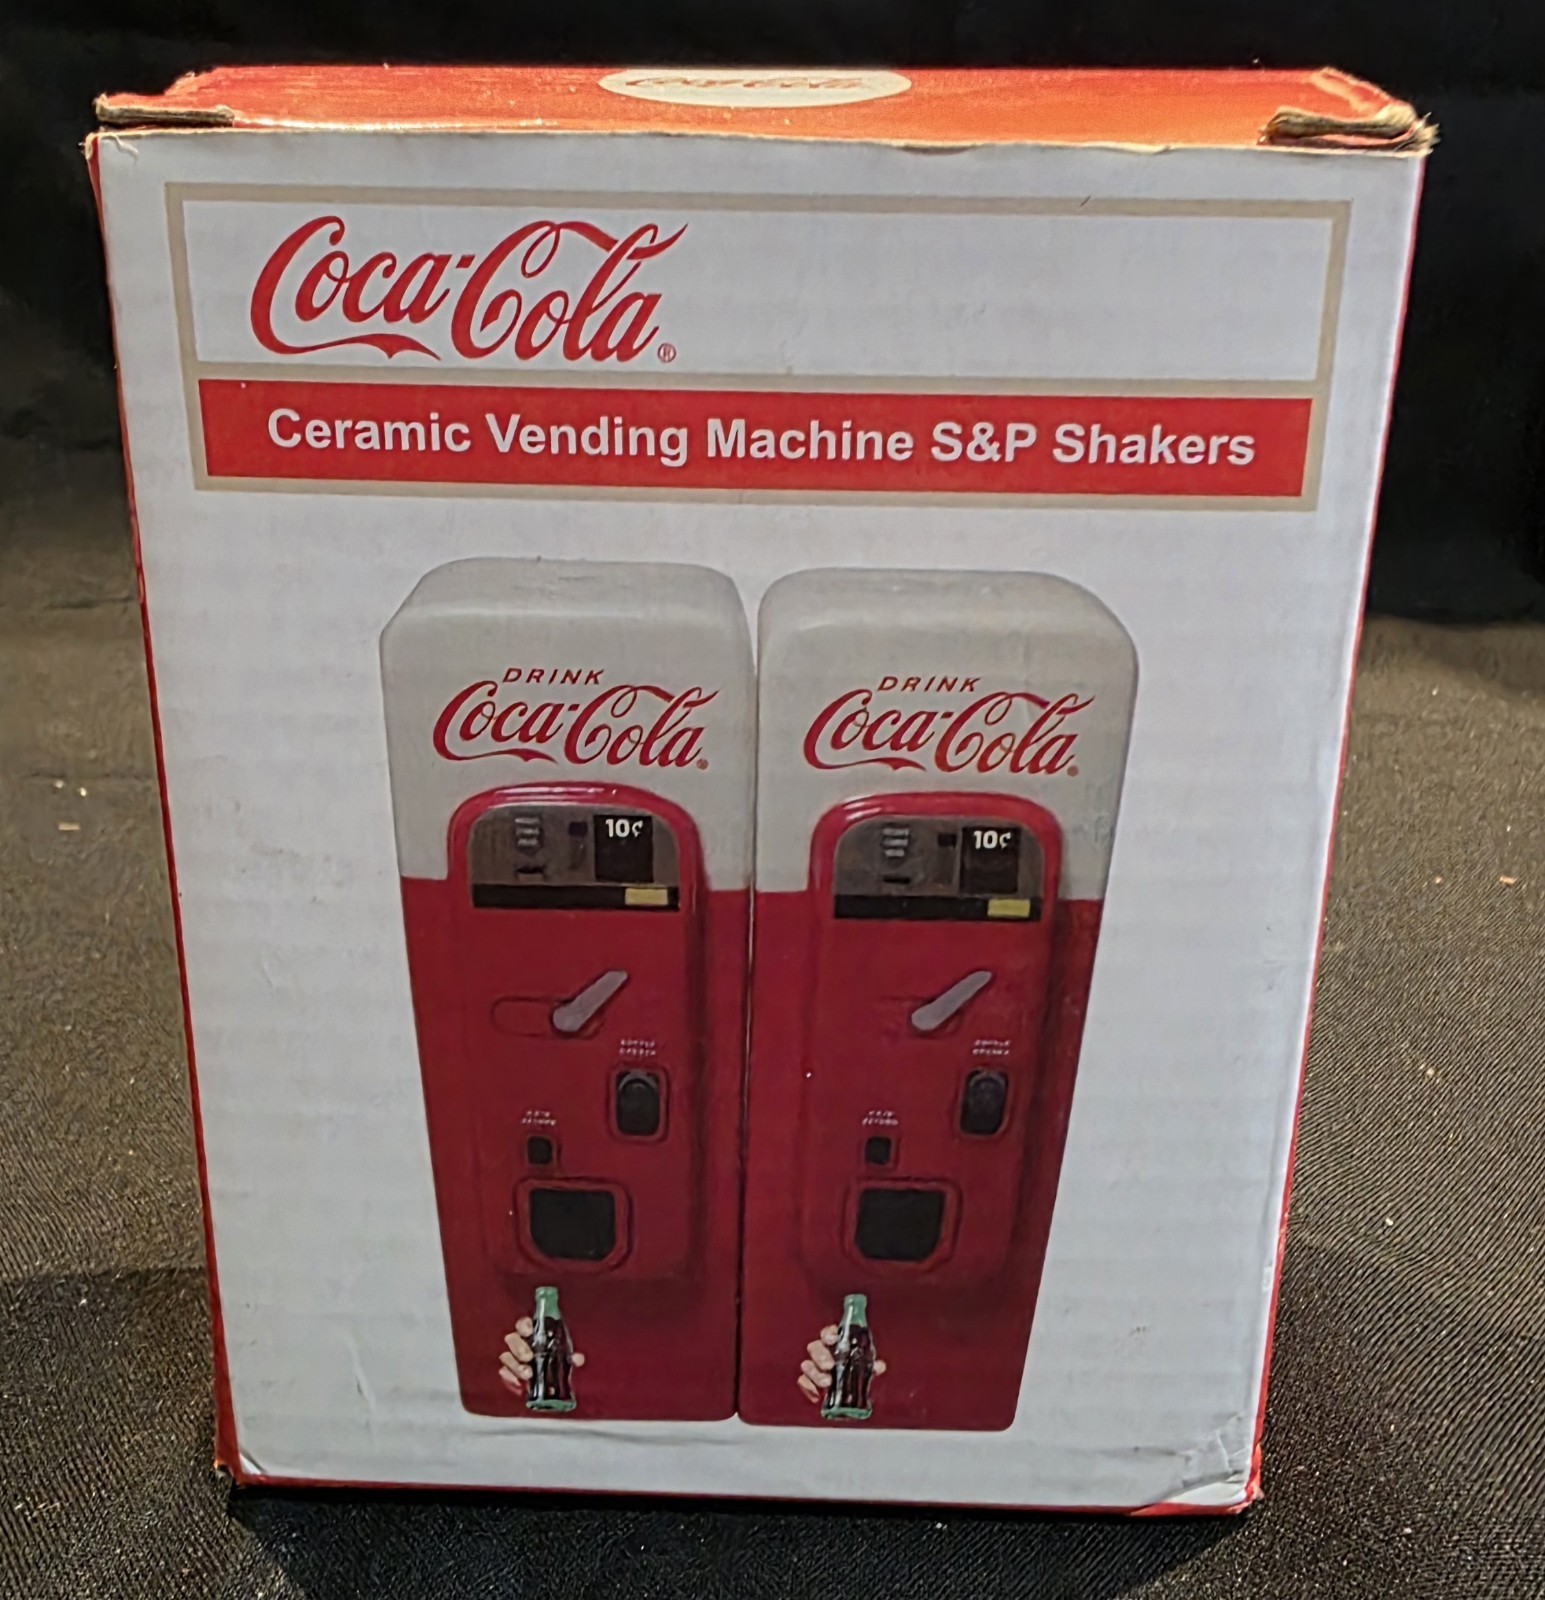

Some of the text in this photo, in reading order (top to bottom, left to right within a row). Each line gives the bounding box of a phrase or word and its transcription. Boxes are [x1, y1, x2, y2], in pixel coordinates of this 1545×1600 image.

[250, 215, 688, 363] Coca-Cola
[267, 408, 1256, 468] Ceramic Vending Machine S&P Shakers
[502, 667, 604, 685] DRINK
[877, 676, 982, 692] DRINK
[432, 680, 720, 769] Coca-Cola
[803, 689, 1095, 776] Coca-Cola
